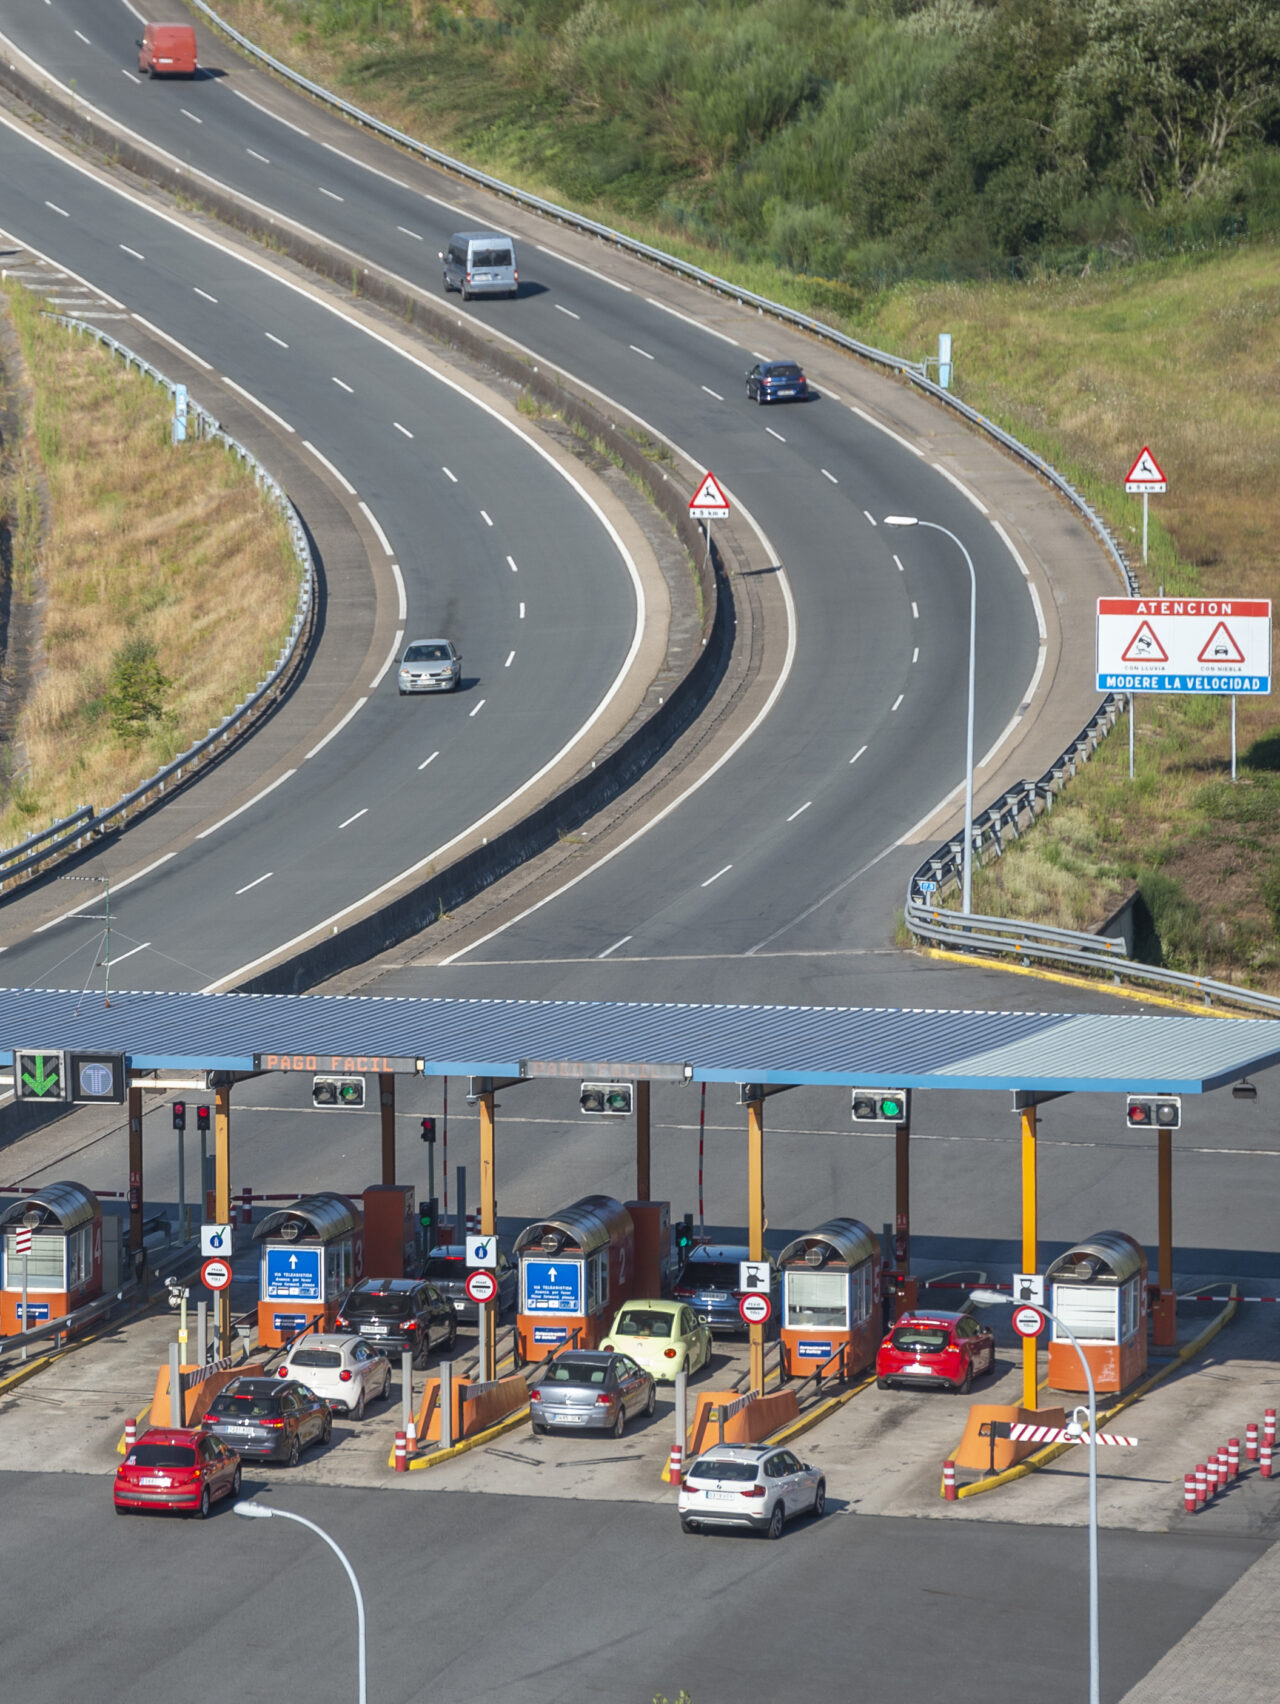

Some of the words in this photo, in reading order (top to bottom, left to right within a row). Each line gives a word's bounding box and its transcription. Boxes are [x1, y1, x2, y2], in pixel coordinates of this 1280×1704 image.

[1136, 603, 1232, 615] ATENCION
[1106, 676, 1159, 688] MODERE
[1165, 677, 1181, 688] LA
[1186, 678, 1260, 690] VELOCIDAD
[267, 1056, 317, 1070] PAGO
[331, 1057, 393, 1071] FACIL
[94, 1228, 102, 1264] 4
